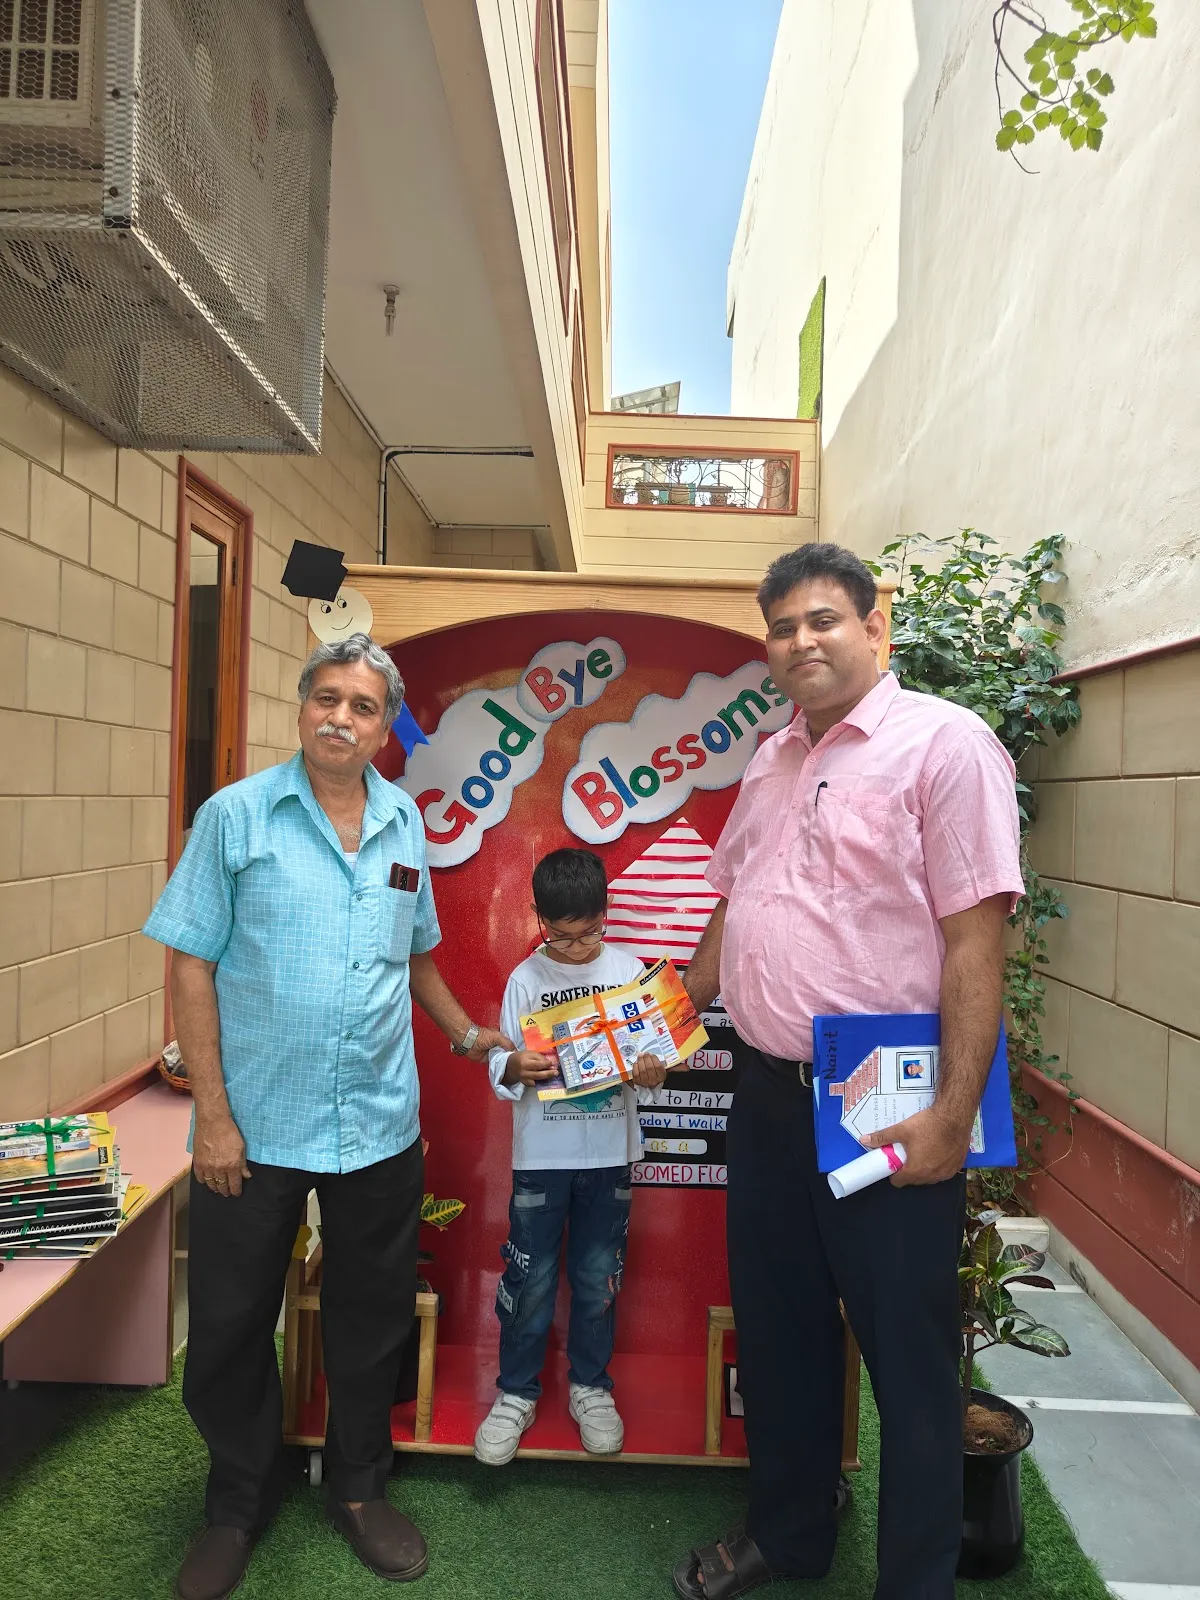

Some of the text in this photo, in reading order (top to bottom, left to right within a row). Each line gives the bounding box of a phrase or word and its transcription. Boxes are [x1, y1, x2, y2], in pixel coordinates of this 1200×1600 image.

[415, 648, 613, 844] Good Bye
[572, 675, 790, 829] Blossoms
[541, 986, 590, 1008] SKATER
[624, 1002, 642, 1031] DOS
[692, 1049, 732, 1069] BUD
[666, 1090, 682, 1105] to
[638, 1114, 724, 1131] oday I walk
[650, 1140, 688, 1152] as a
[632, 1164, 693, 1183] SOMED
